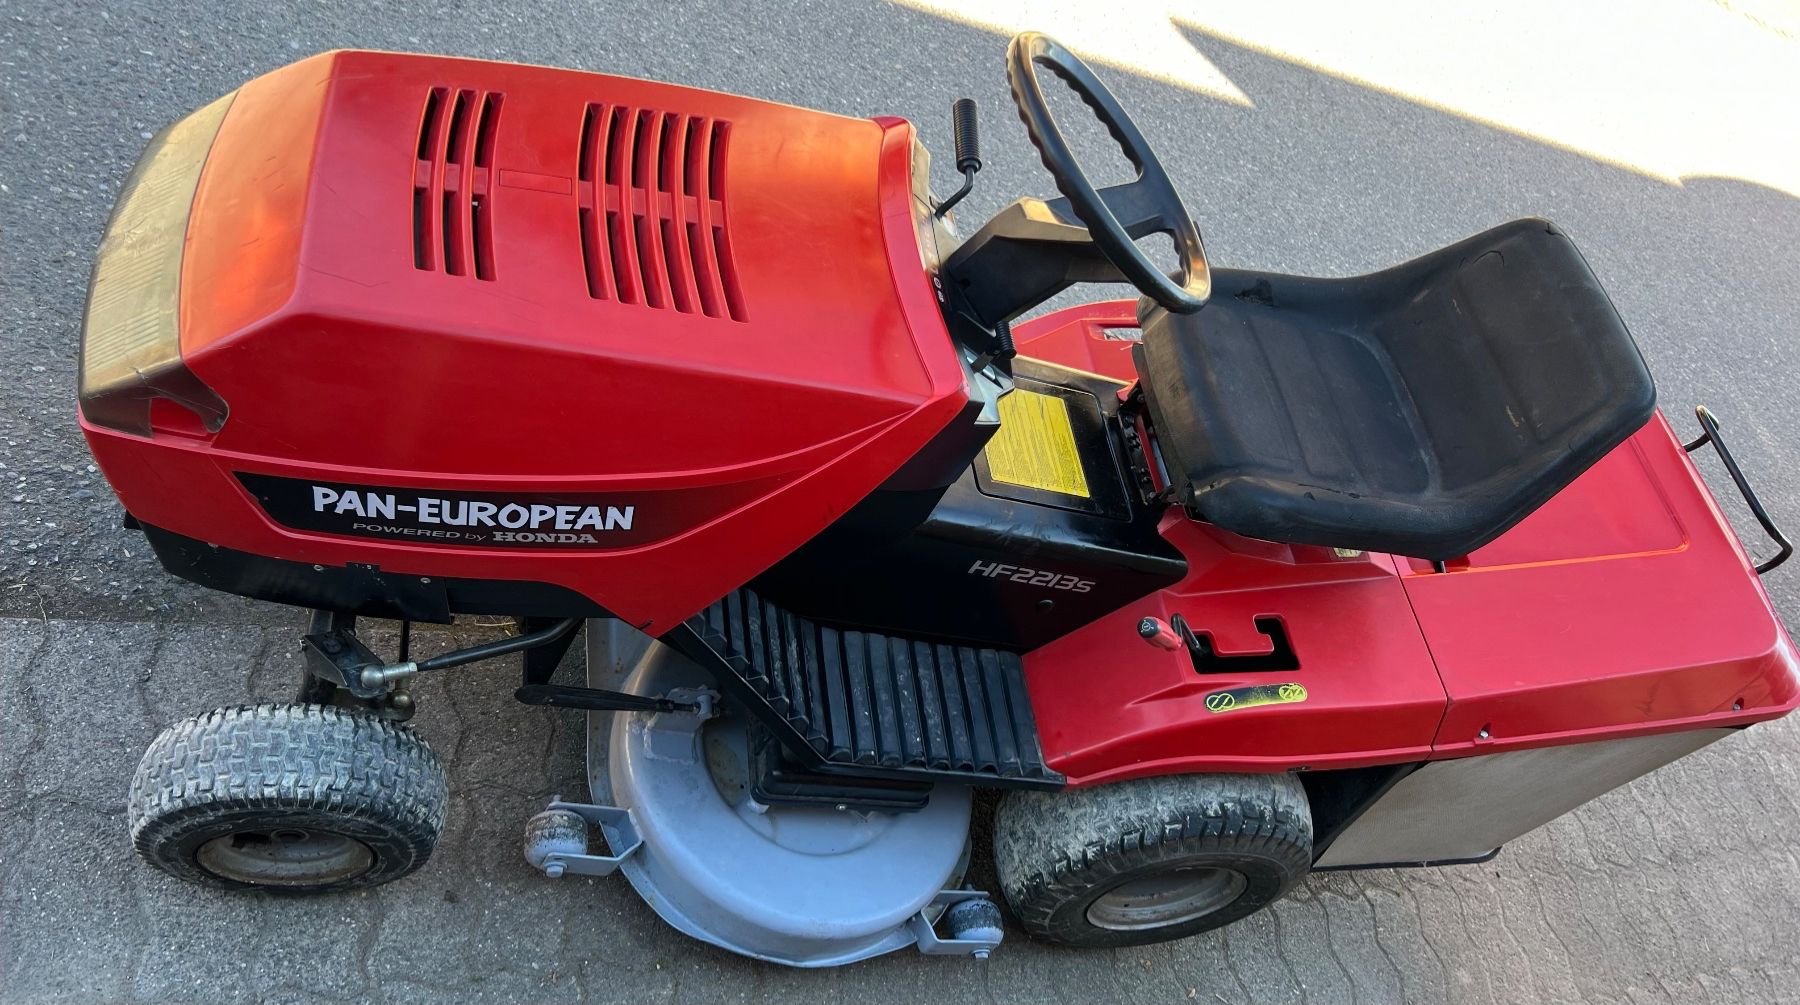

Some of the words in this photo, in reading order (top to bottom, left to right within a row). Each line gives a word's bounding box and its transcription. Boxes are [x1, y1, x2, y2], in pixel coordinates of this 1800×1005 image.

[312, 486, 634, 531] PAN-EUROPEAN
[353, 522, 460, 539] POWERED
[465, 532, 487, 542] by
[492, 531, 598, 544] HONDA
[967, 560, 1096, 593] HF2213S
